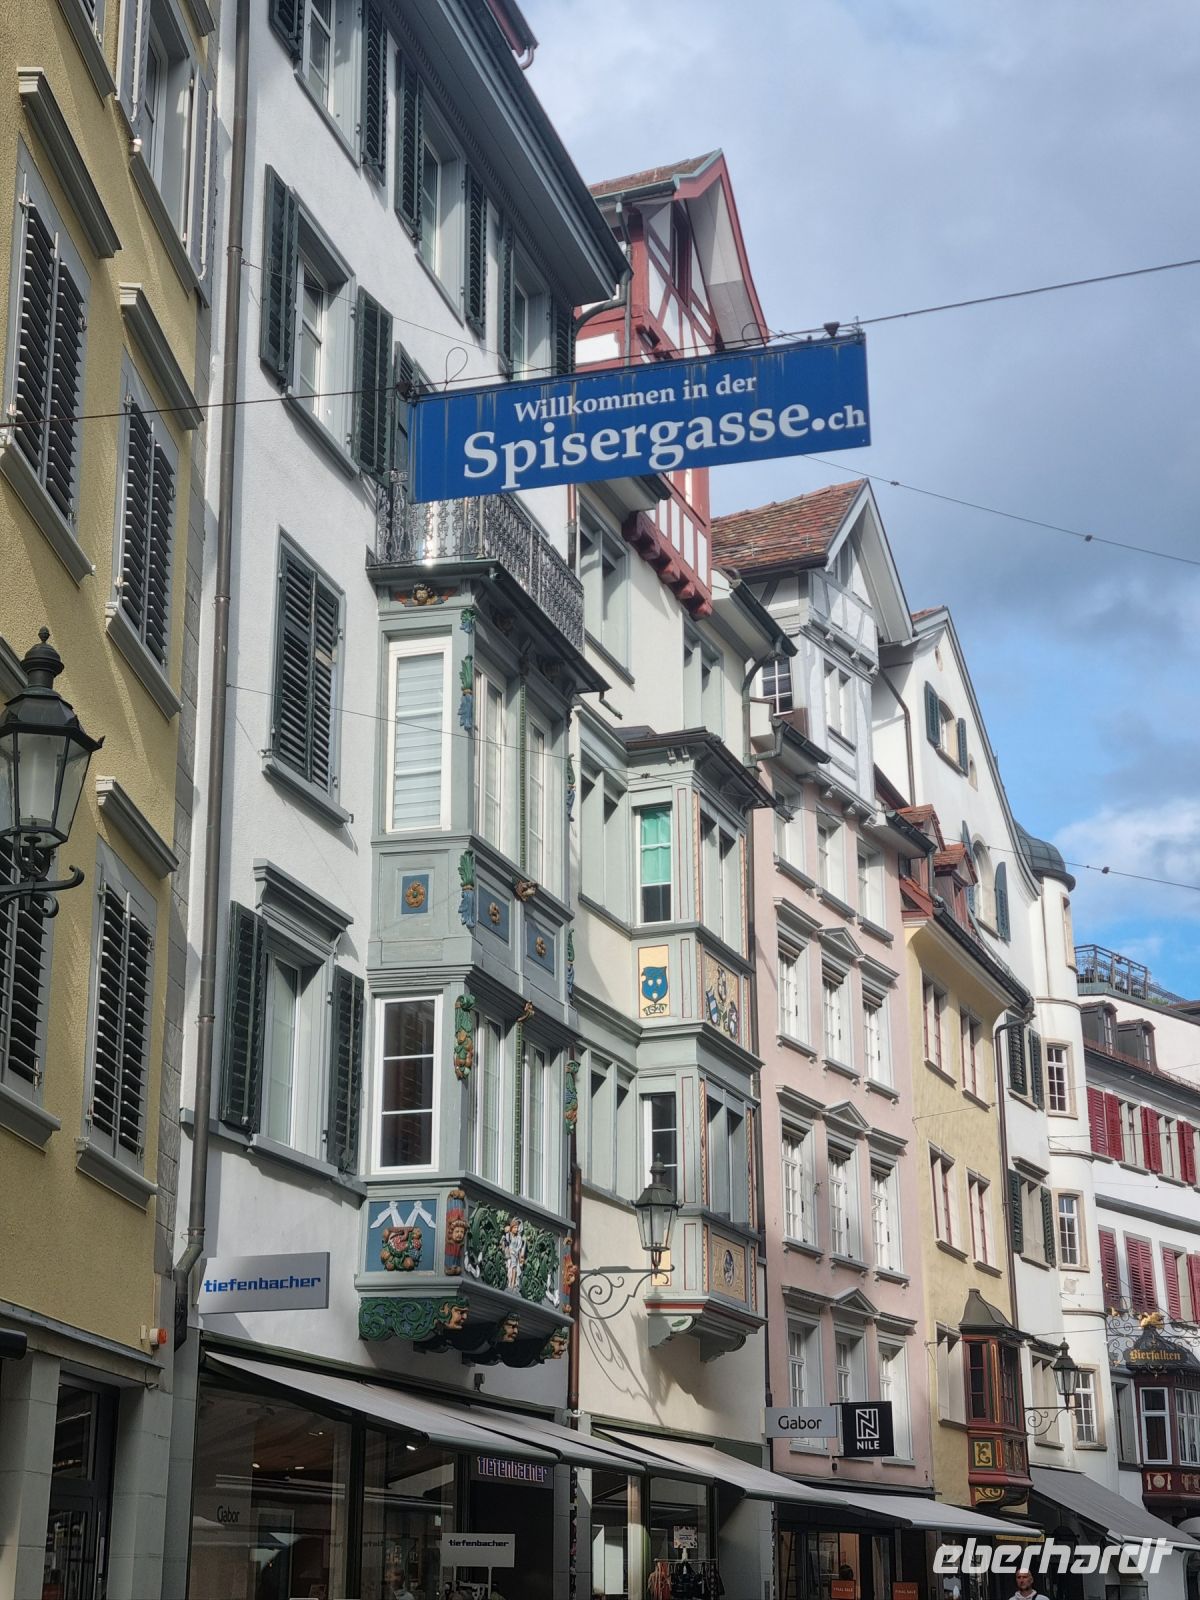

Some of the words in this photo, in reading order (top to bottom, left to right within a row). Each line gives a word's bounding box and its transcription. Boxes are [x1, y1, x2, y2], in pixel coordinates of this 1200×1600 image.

[513, 385, 676, 422] Willkommen
[683, 380, 708, 399] in
[715, 374, 757, 395] der
[463, 403, 867, 490] Spisergasse.ch
[204, 1276, 321, 1292] tiefenbacher
[778, 1415, 822, 1430] Gabor
[856, 1440, 880, 1450] NILE
[216, 1505, 240, 1523] Gabor
[448, 1539, 509, 1547] tiefenbacher
